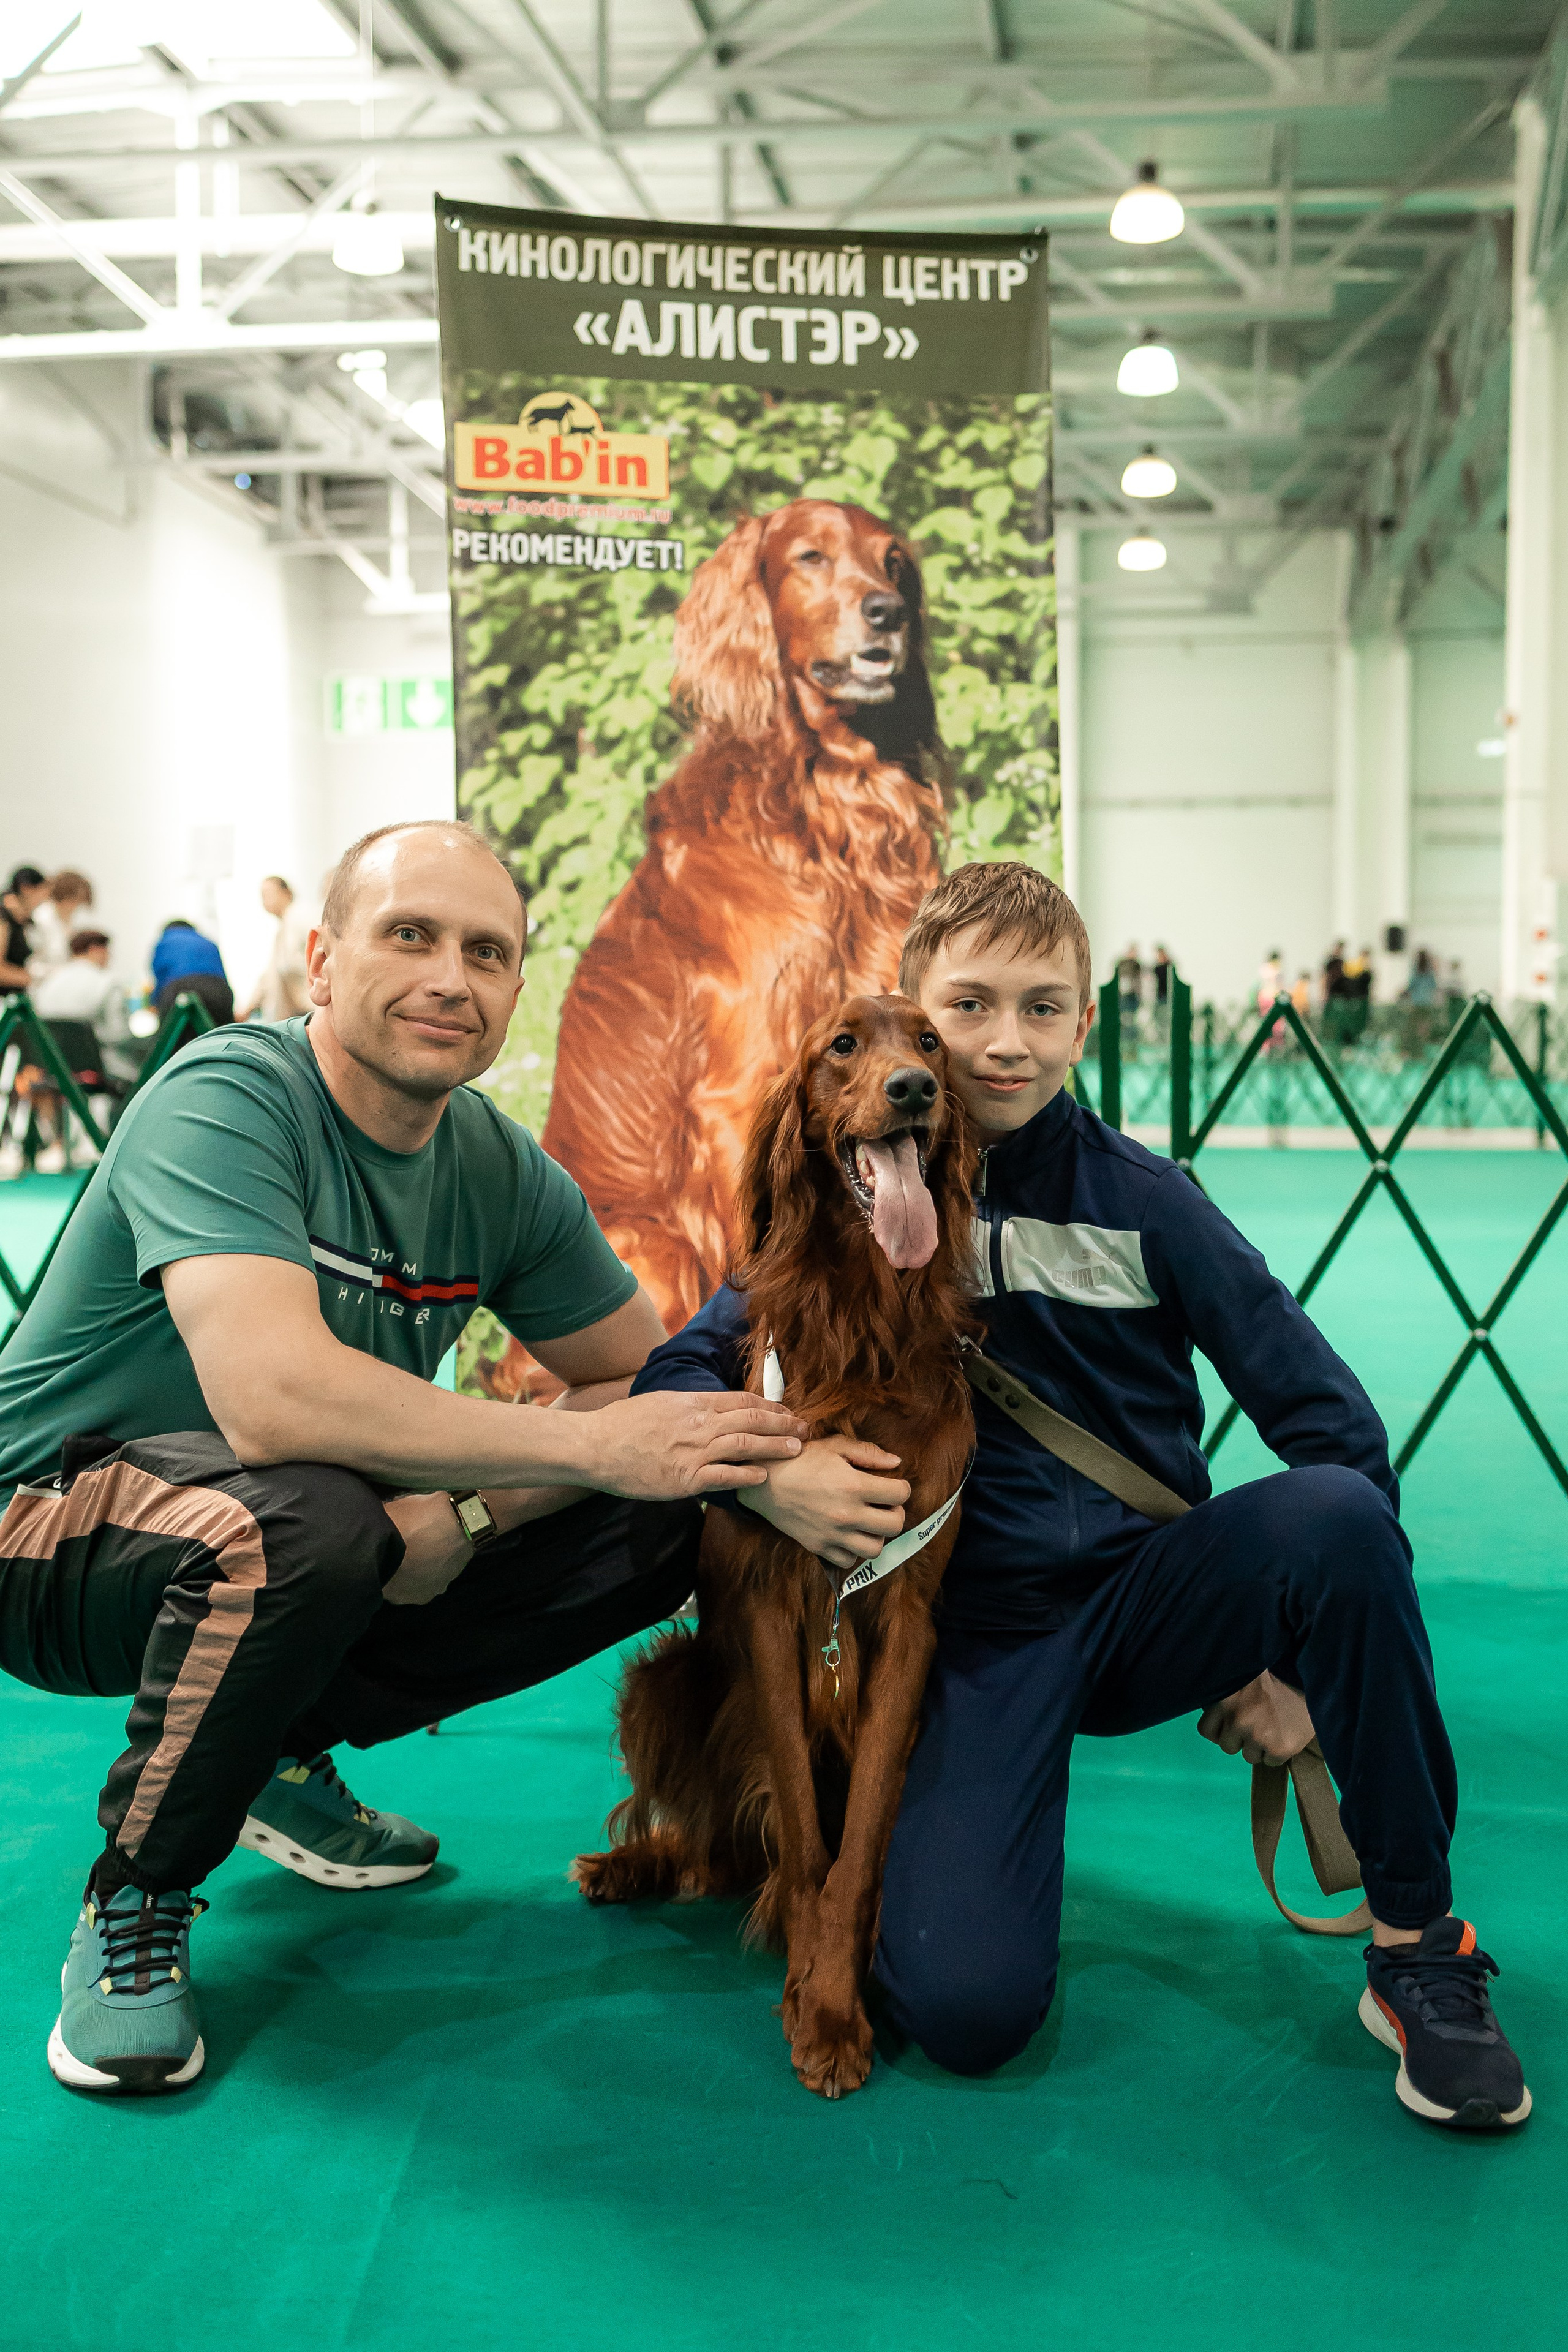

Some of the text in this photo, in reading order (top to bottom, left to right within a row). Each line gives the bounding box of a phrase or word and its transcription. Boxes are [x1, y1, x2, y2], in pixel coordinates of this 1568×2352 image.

[458, 227, 1029, 306] КИНОЛОГИЧЕСКИЙ ЦЕНТР
[573, 298, 920, 366] «АЛИСТЭР»
[473, 436, 647, 487] Bab'in
[452, 495, 672, 524] www.foodpremium.ru
[451, 527, 684, 571] РЕКОМЕНДУЕТ!
[918, 1521, 936, 1540] Super
[846, 1561, 878, 1591] PRIX
